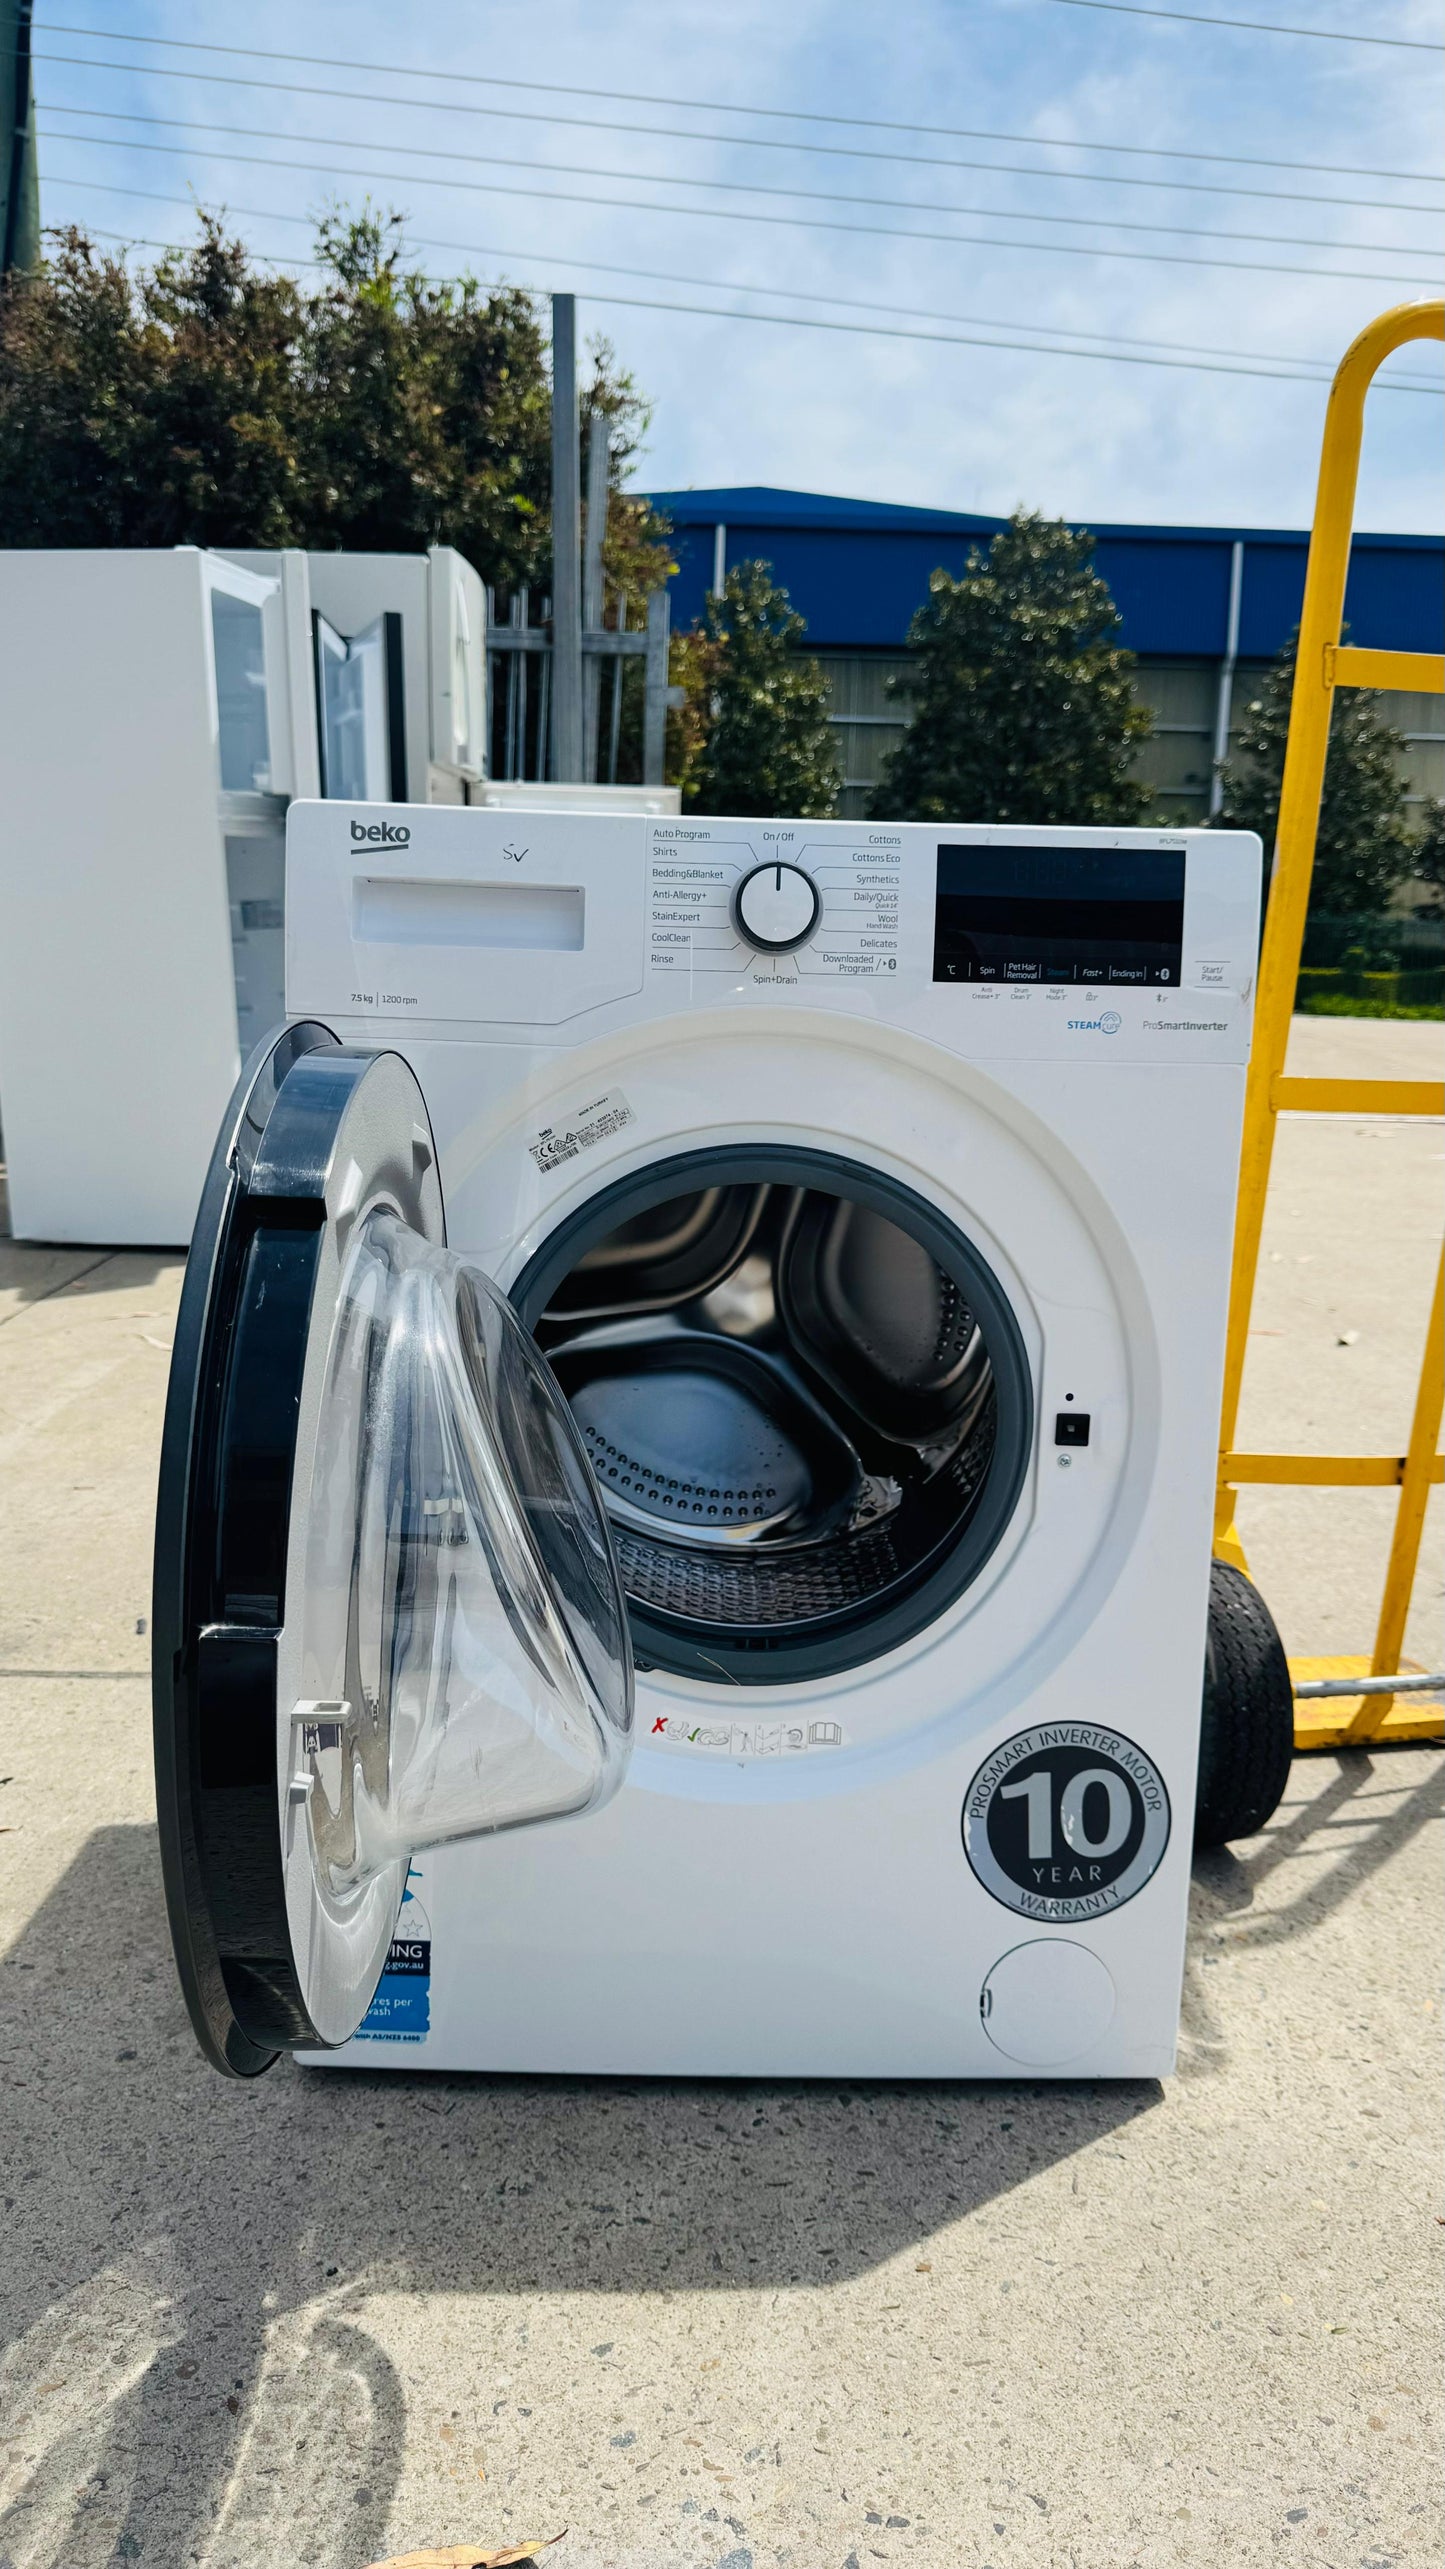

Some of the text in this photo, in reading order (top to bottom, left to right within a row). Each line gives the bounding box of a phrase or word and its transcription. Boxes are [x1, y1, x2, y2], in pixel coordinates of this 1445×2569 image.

[351, 820, 410, 843] beko
[653, 829, 710, 840] Auto Program
[869, 835, 901, 844] Cottons
[653, 847, 678, 856] Shirts
[852, 853, 900, 863] Cottons Eco
[652, 868, 724, 880] Bedding&Blanket
[856, 874, 899, 885] Synthetics
[652, 890, 707, 901] Anti-Allergy+
[854, 892, 899, 903] Daily/Quick
[652, 911, 700, 922] StainExpert
[878, 914, 898, 923] Wool
[651, 933, 691, 942] CoolClean
[860, 939, 898, 948] Delicates
[651, 954, 674, 963] Rinse
[822, 954, 874, 963] Downloaded
[838, 964, 874, 974] Program
[979, 966, 996, 975] Spin
[1008, 962, 1038, 971] Pet Hair
[1202, 966, 1223, 974] Start/
[753, 975, 798, 984] Spin+Drain
[1112, 970, 1135, 979] Ending
[1202, 974, 1223, 982] Pause
[1049, 987, 1064, 995] Night
[364, 994, 373, 1004] kg
[382, 995, 418, 1005] 1200 rpm
[1143, 1020, 1228, 1031] ProSmartInverter
[538, 1128, 553, 1138] beko
[970, 1728, 1162, 1819] PROSMART INVERTER MOTOR
[1000, 1768, 1132, 1860] 10
[1032, 1865, 1101, 1883] YEAR
[1020, 1885, 1119, 1915] WARRANTY
[392, 1944, 422, 1958] ING
[394, 1999, 413, 2008] per
